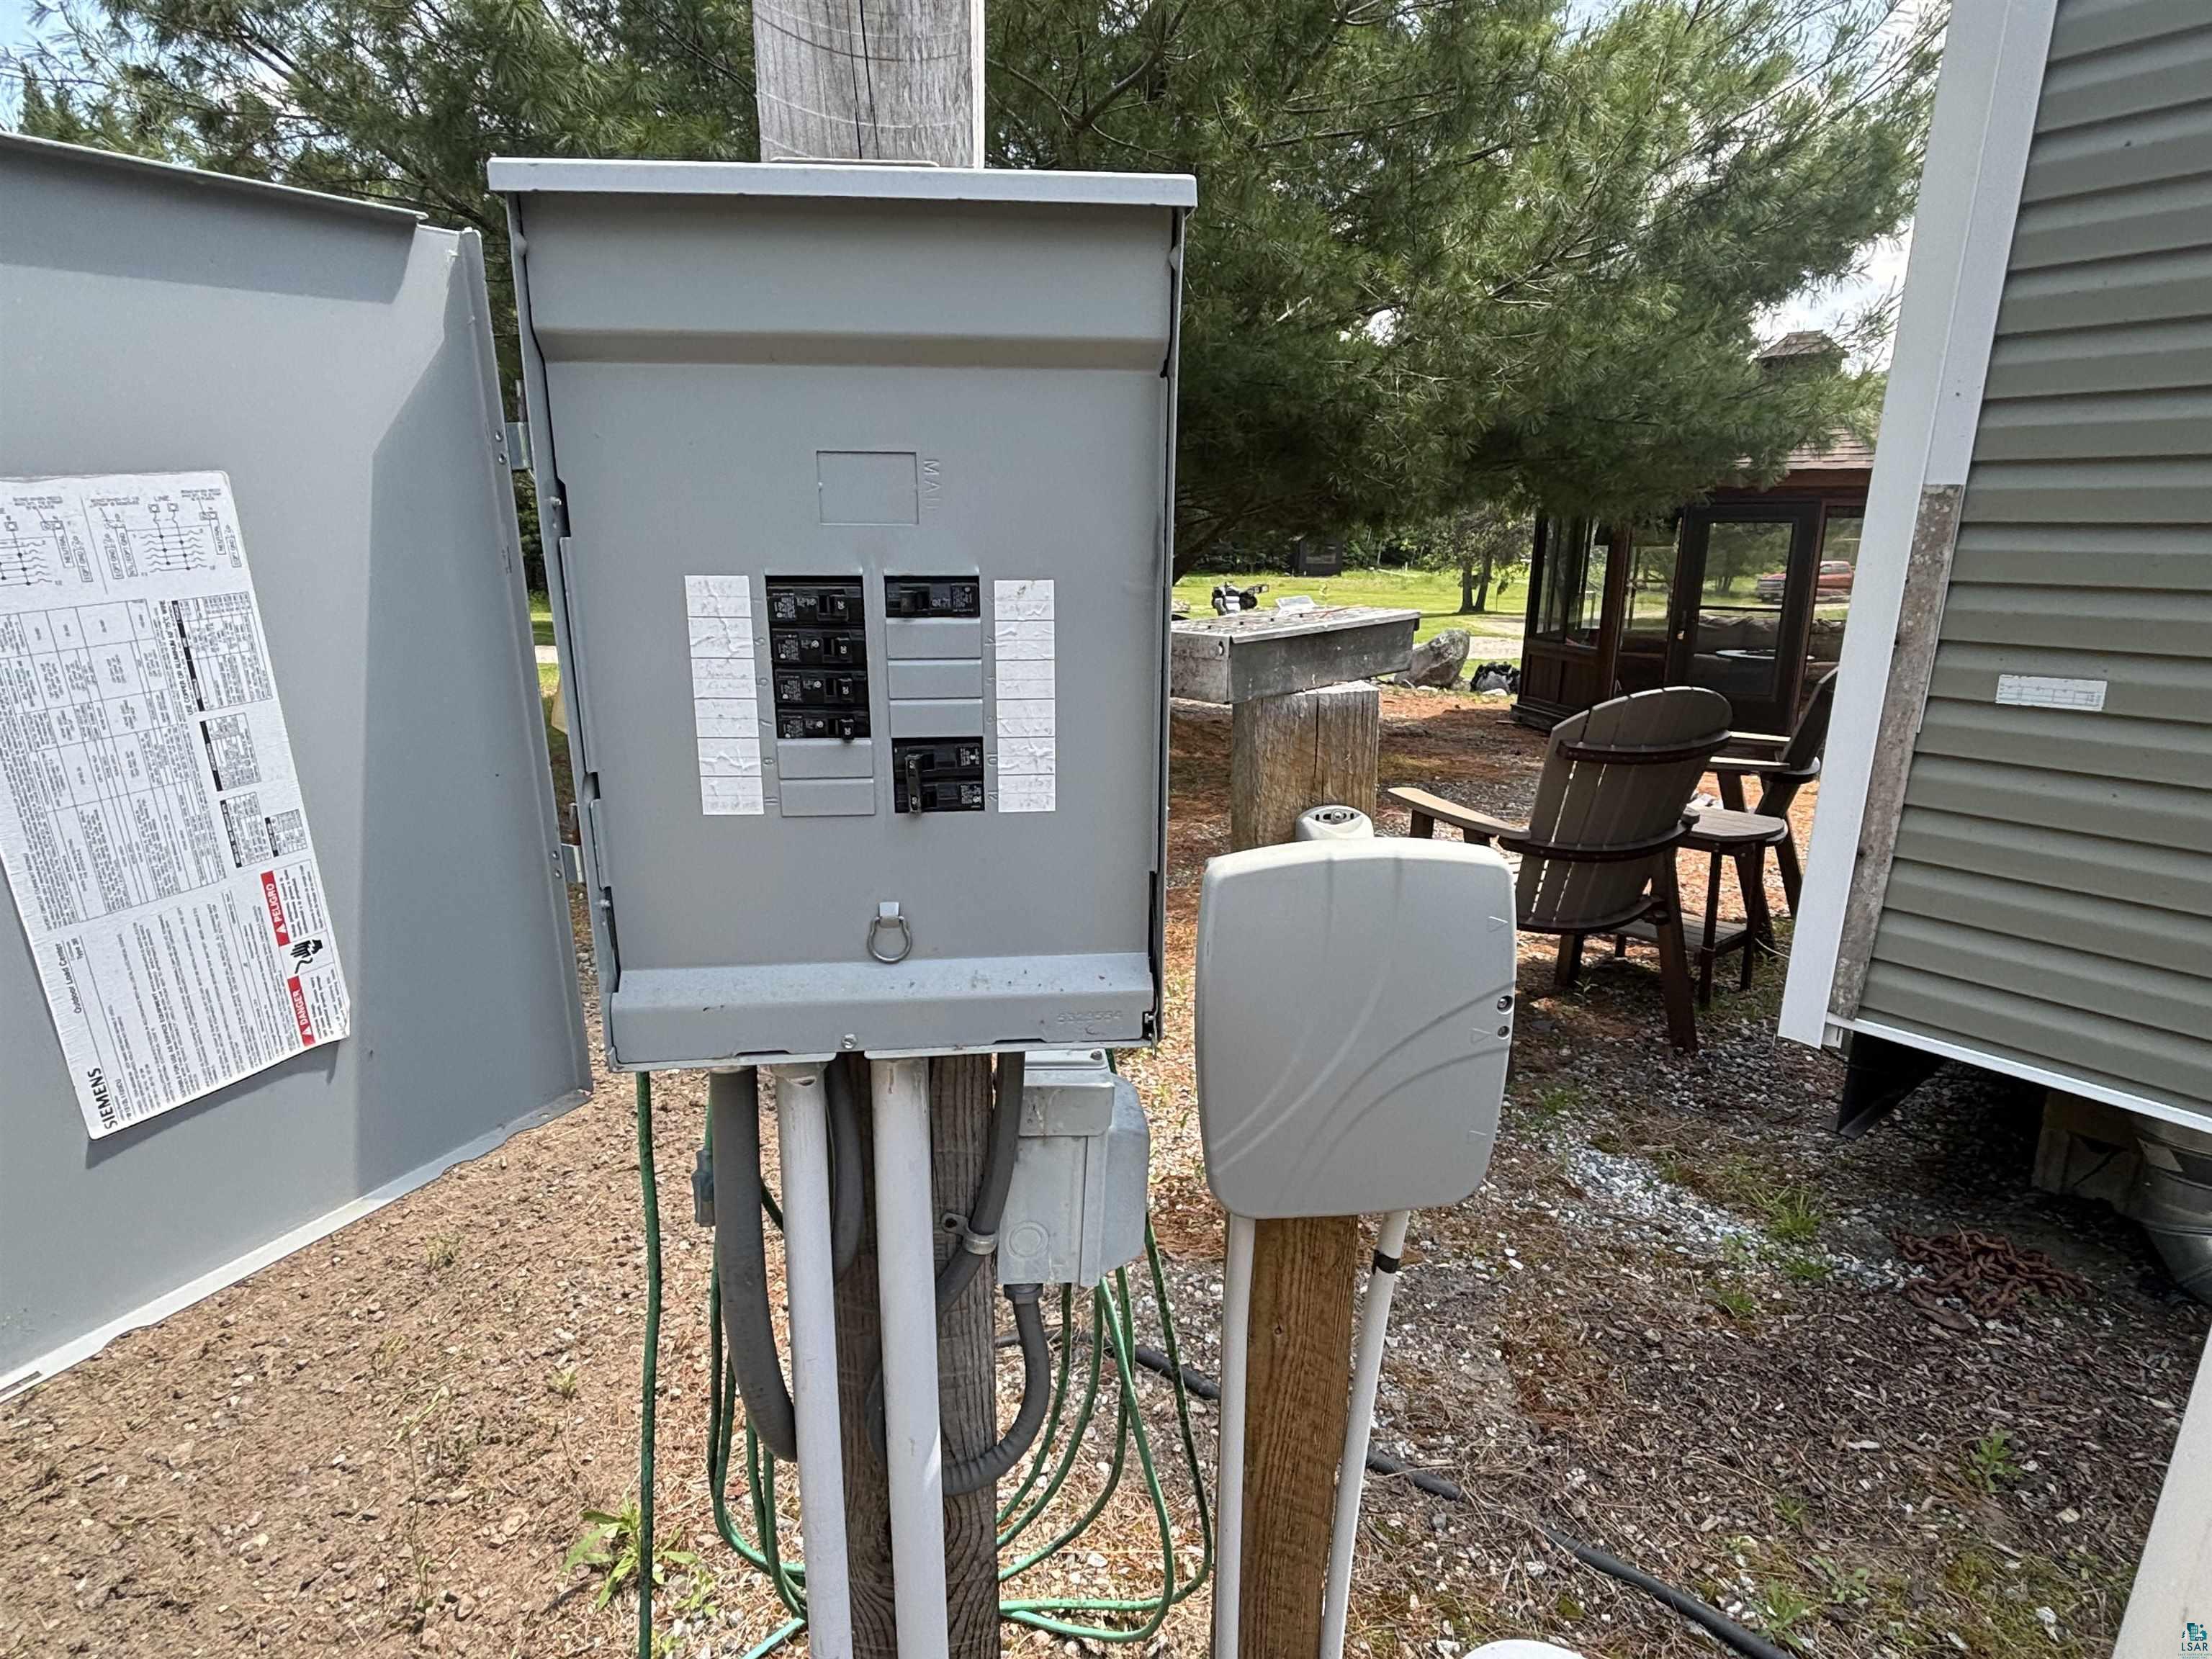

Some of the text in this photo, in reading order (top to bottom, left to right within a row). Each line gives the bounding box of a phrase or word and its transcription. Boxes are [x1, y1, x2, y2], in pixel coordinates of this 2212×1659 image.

[266, 883, 282, 922] PELIGRO
[55, 943, 67, 966] Center
[62, 967, 73, 985] Load
[68, 986, 81, 1014] Outdoor
[293, 989, 307, 1026] DANGER
[88, 1067, 118, 1128] SIEMENS
